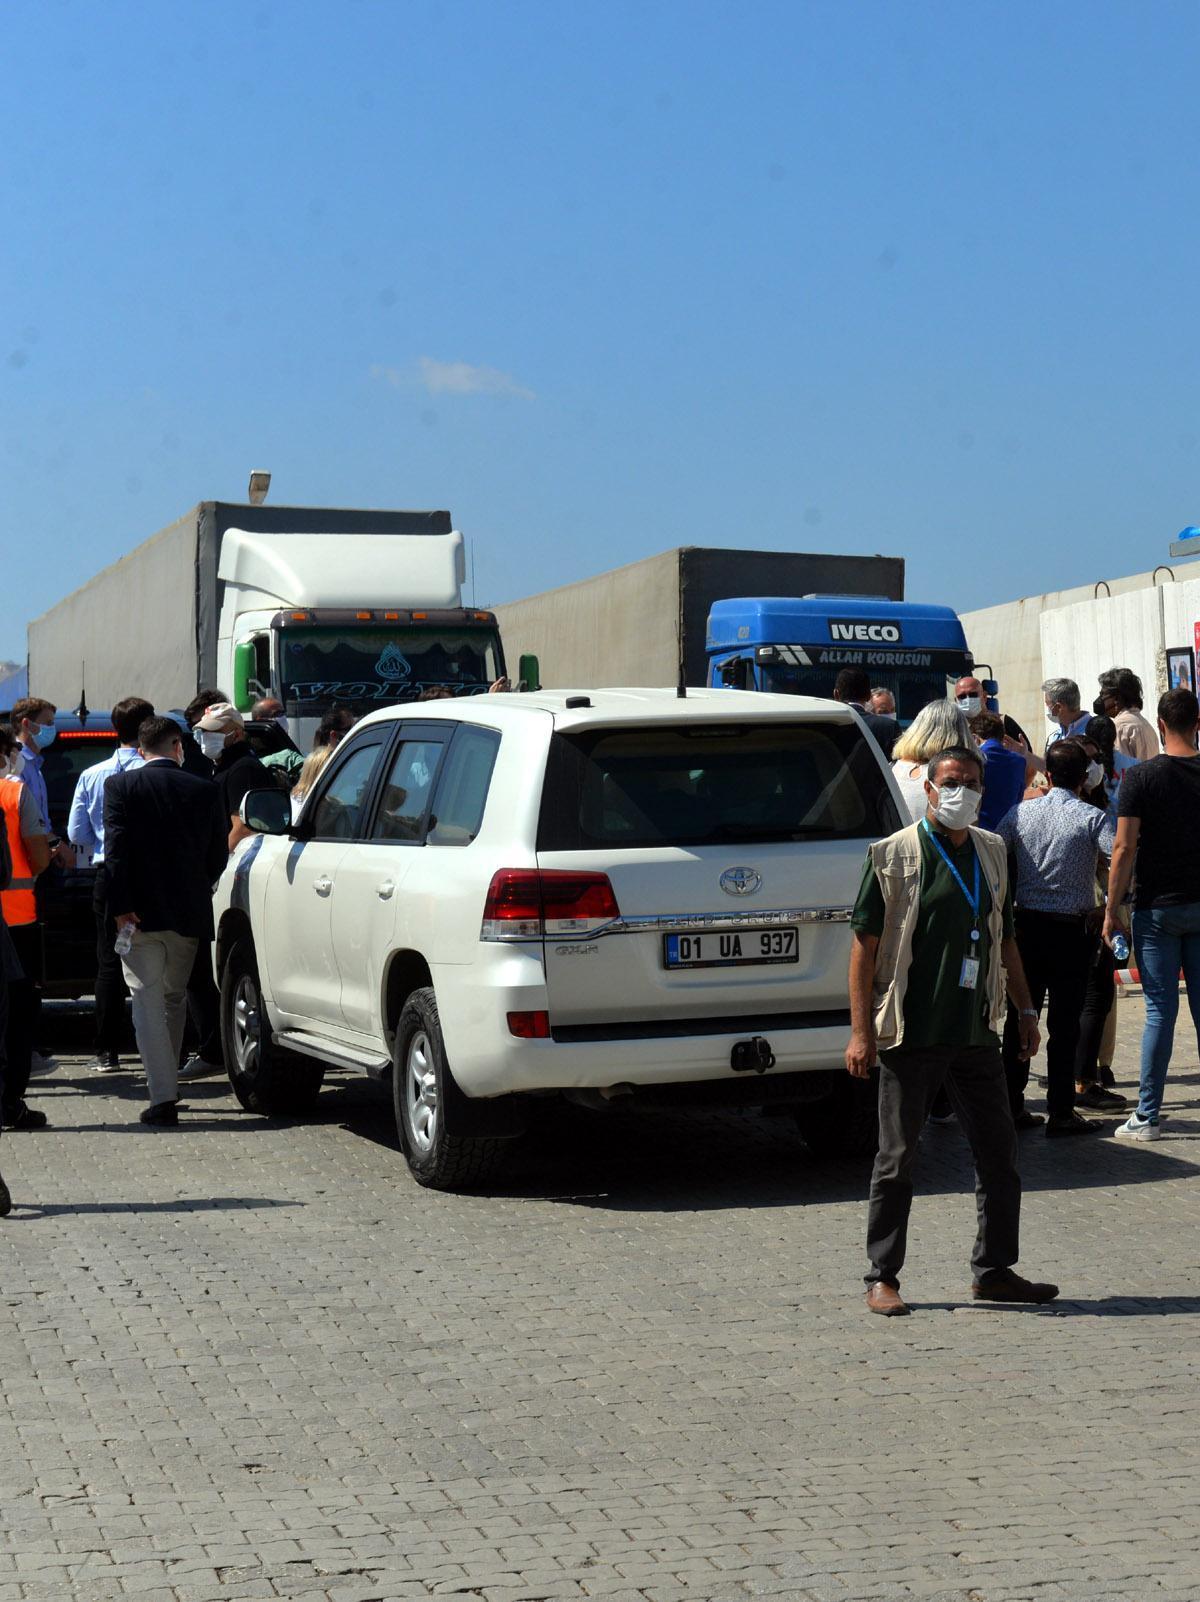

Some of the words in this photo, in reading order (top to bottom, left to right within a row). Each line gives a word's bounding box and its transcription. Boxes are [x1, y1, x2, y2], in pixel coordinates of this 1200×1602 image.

[830, 623, 900, 642] IVECO
[819, 650, 863, 664] ALLAH
[866, 651, 932, 667] KORUSUN
[679, 936, 702, 960] 01
[719, 934, 743, 958] UA
[760, 931, 795, 956] 937
